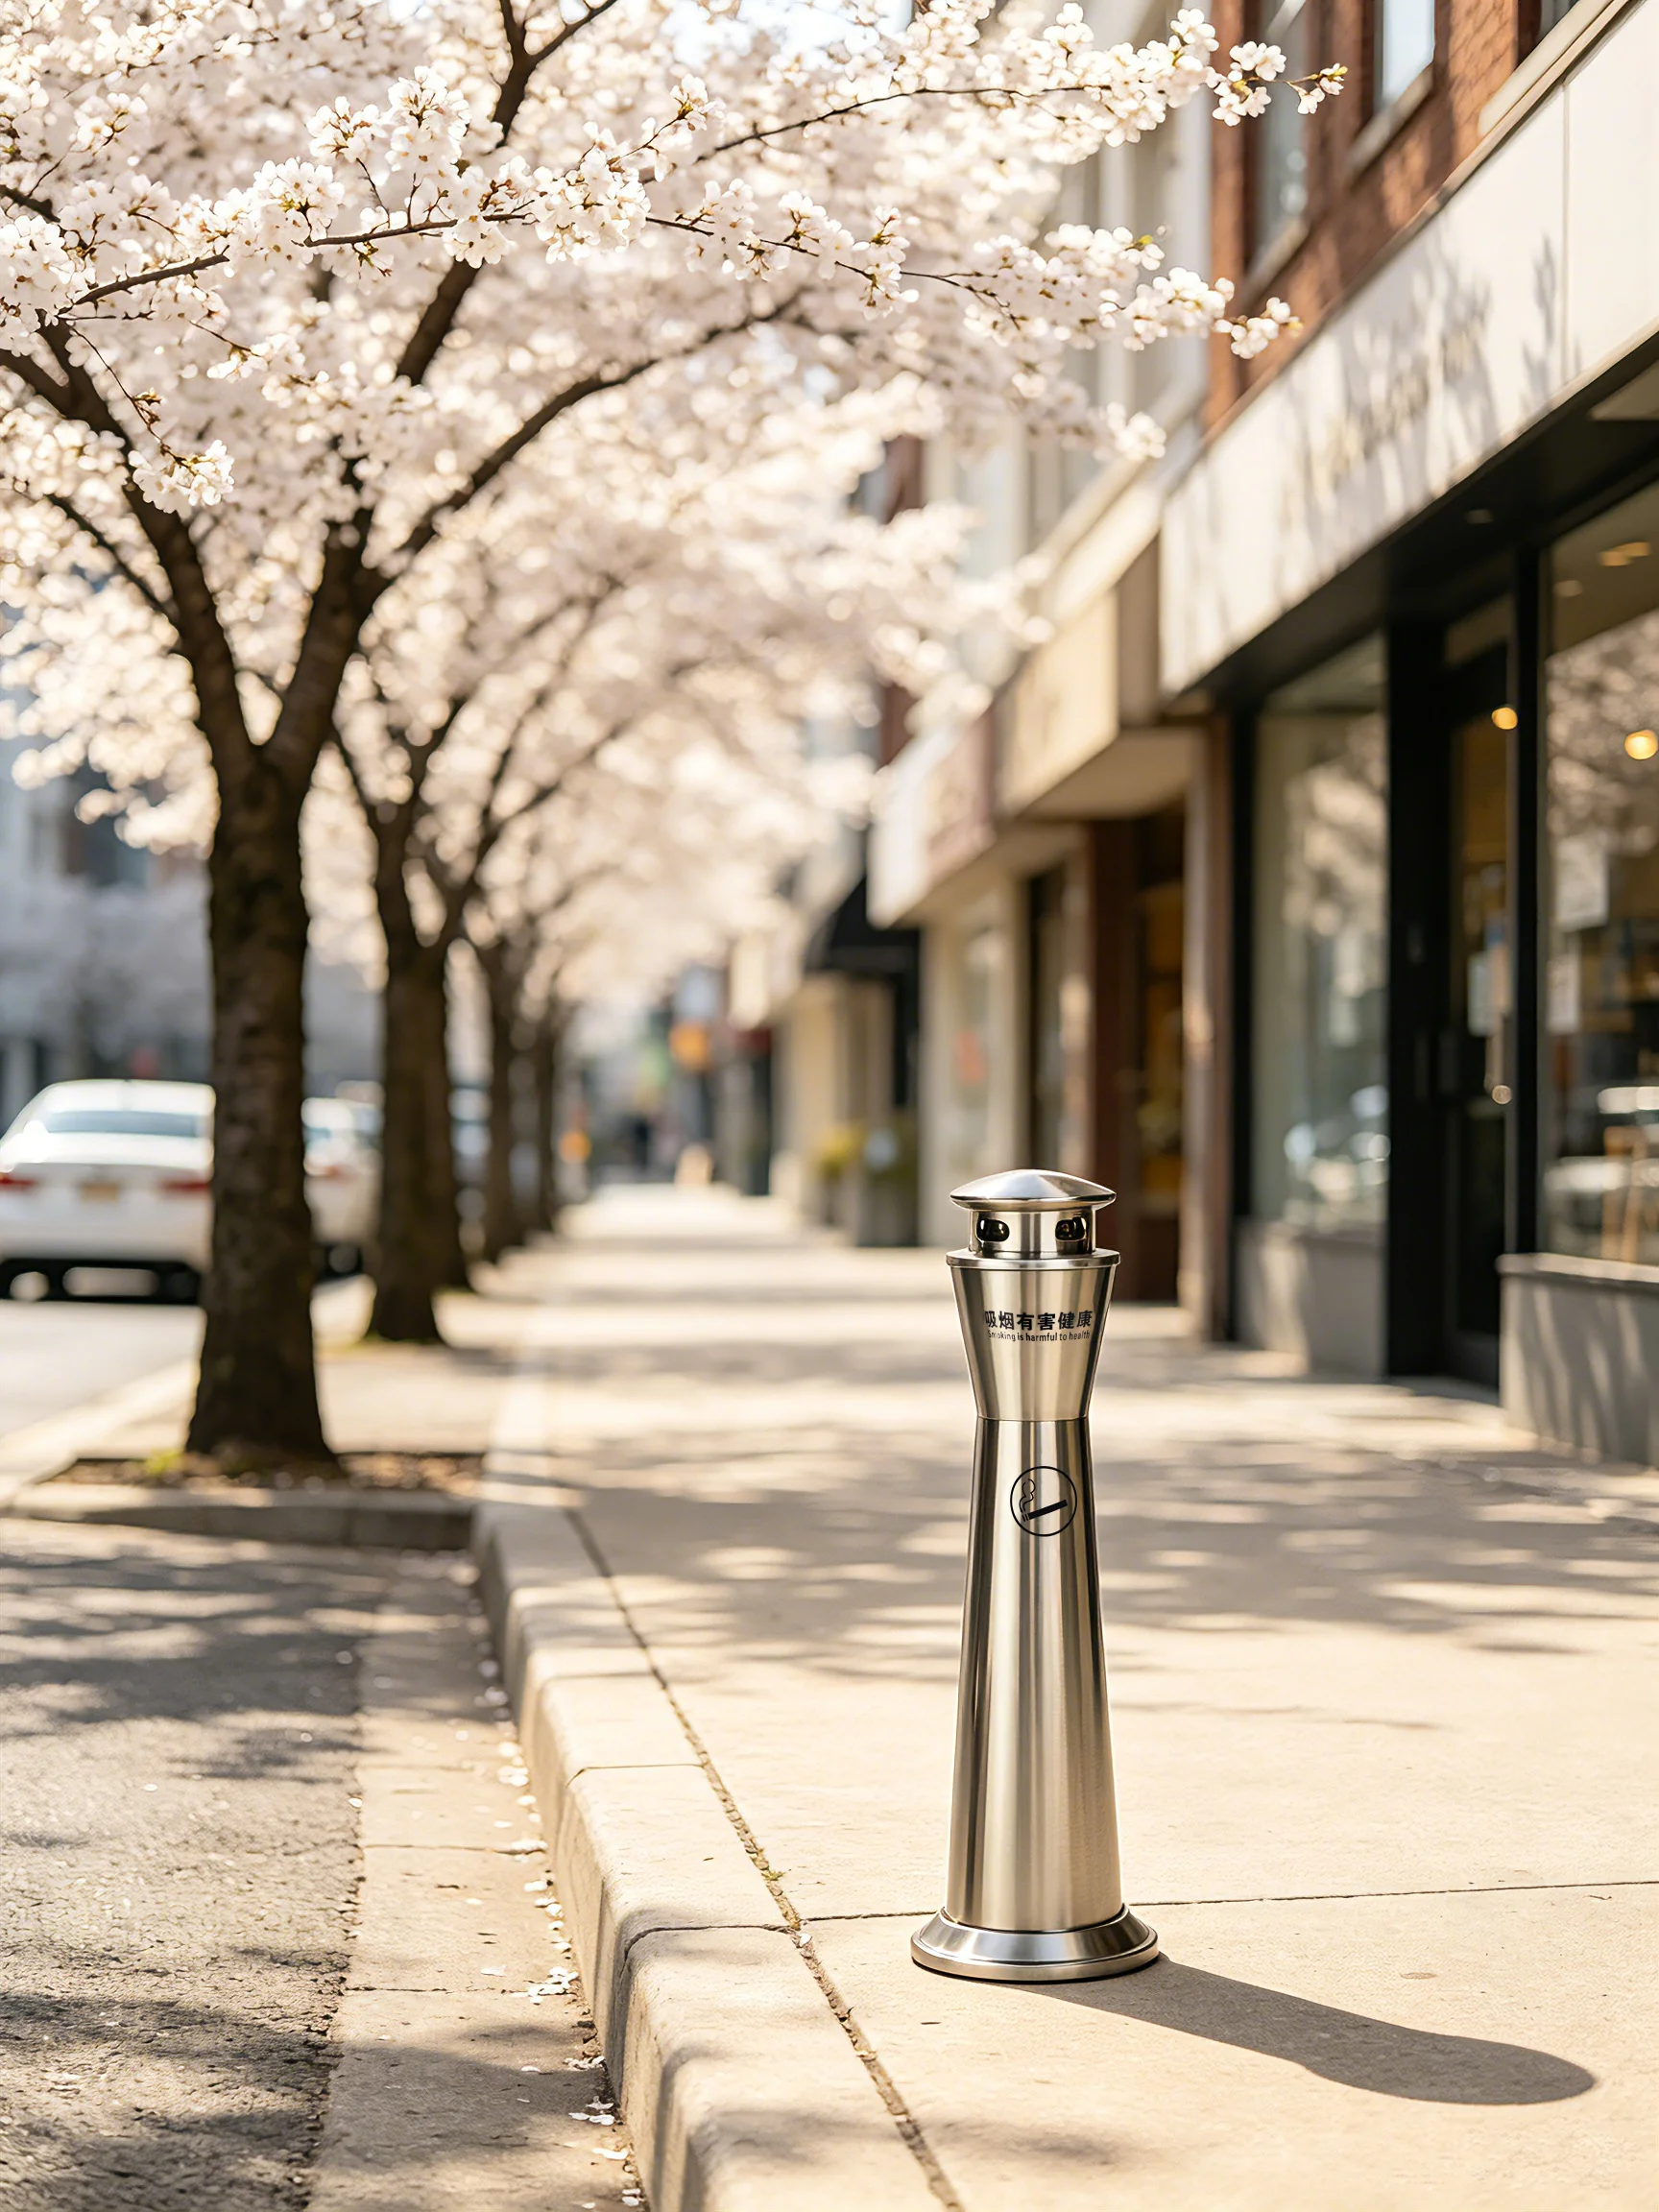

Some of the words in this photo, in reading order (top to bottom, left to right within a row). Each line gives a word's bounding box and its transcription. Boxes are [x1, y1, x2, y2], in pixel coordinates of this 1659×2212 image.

[985, 1310, 1093, 1331] 吸烟有害健康
[988, 1330, 1016, 1342] Smoking
[1017, 1333, 1024, 1341] is
[1025, 1333, 1057, 1341] harmful
[1059, 1333, 1067, 1341] to
[1069, 1331, 1090, 1340] health
